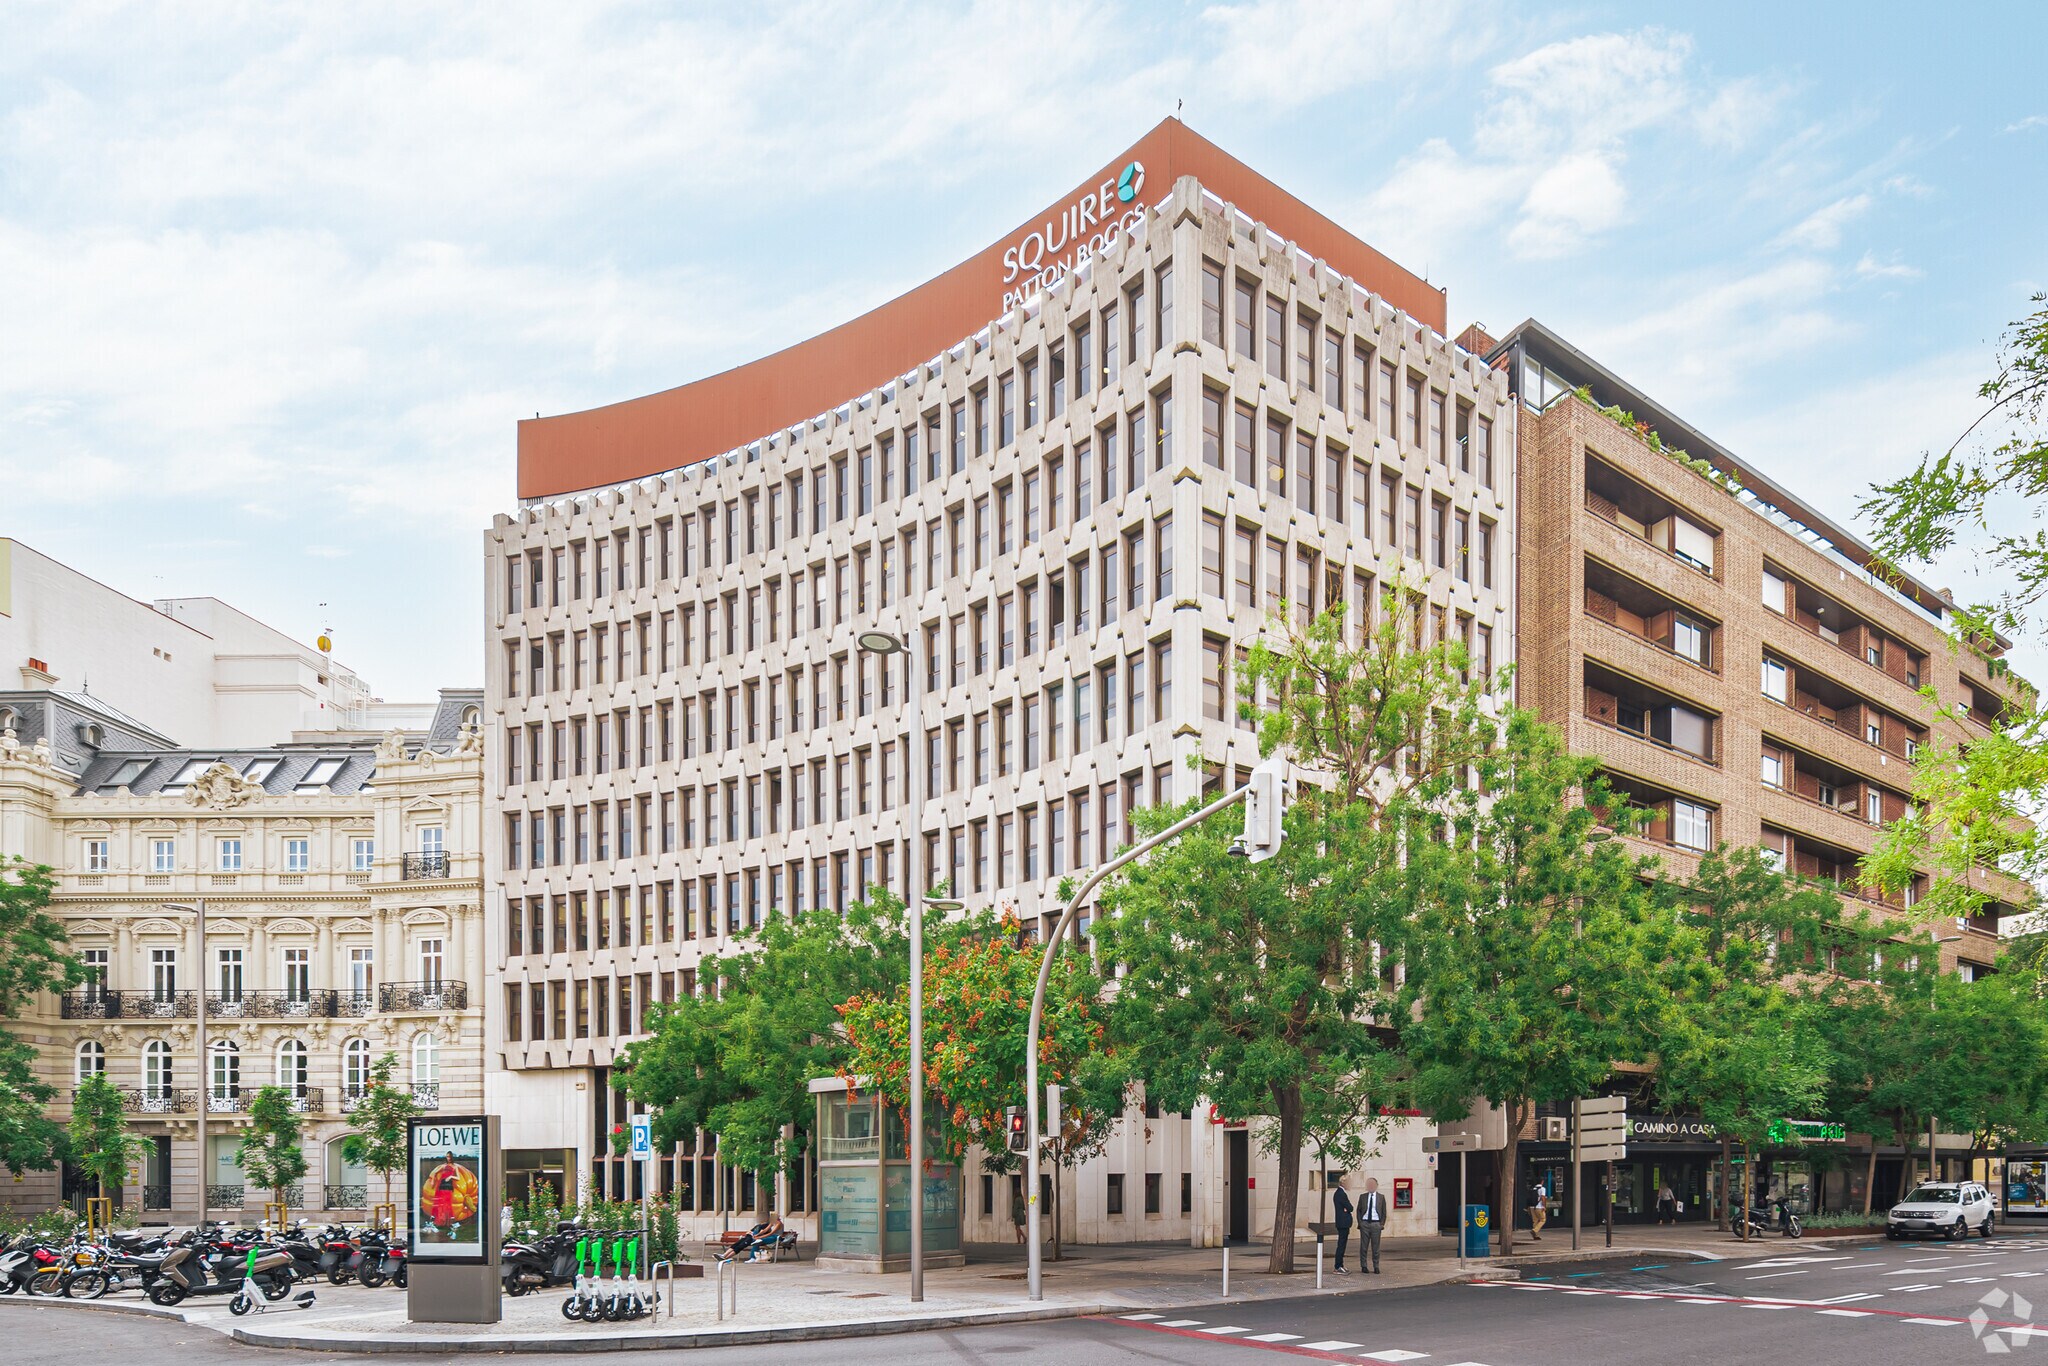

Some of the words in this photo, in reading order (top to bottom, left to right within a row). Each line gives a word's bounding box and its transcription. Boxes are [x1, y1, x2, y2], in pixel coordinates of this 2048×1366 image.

[1003, 177, 1115, 283] SQUIRE
[1003, 254, 1072, 314] PATTON
[1077, 202, 1146, 265] BOGGS
[419, 1126, 480, 1146] LOEWE
[635, 1127, 645, 1150] P
[1634, 1122, 1679, 1134] CAMINO
[1680, 1123, 1689, 1134] A
[1690, 1123, 1717, 1135] CASA
